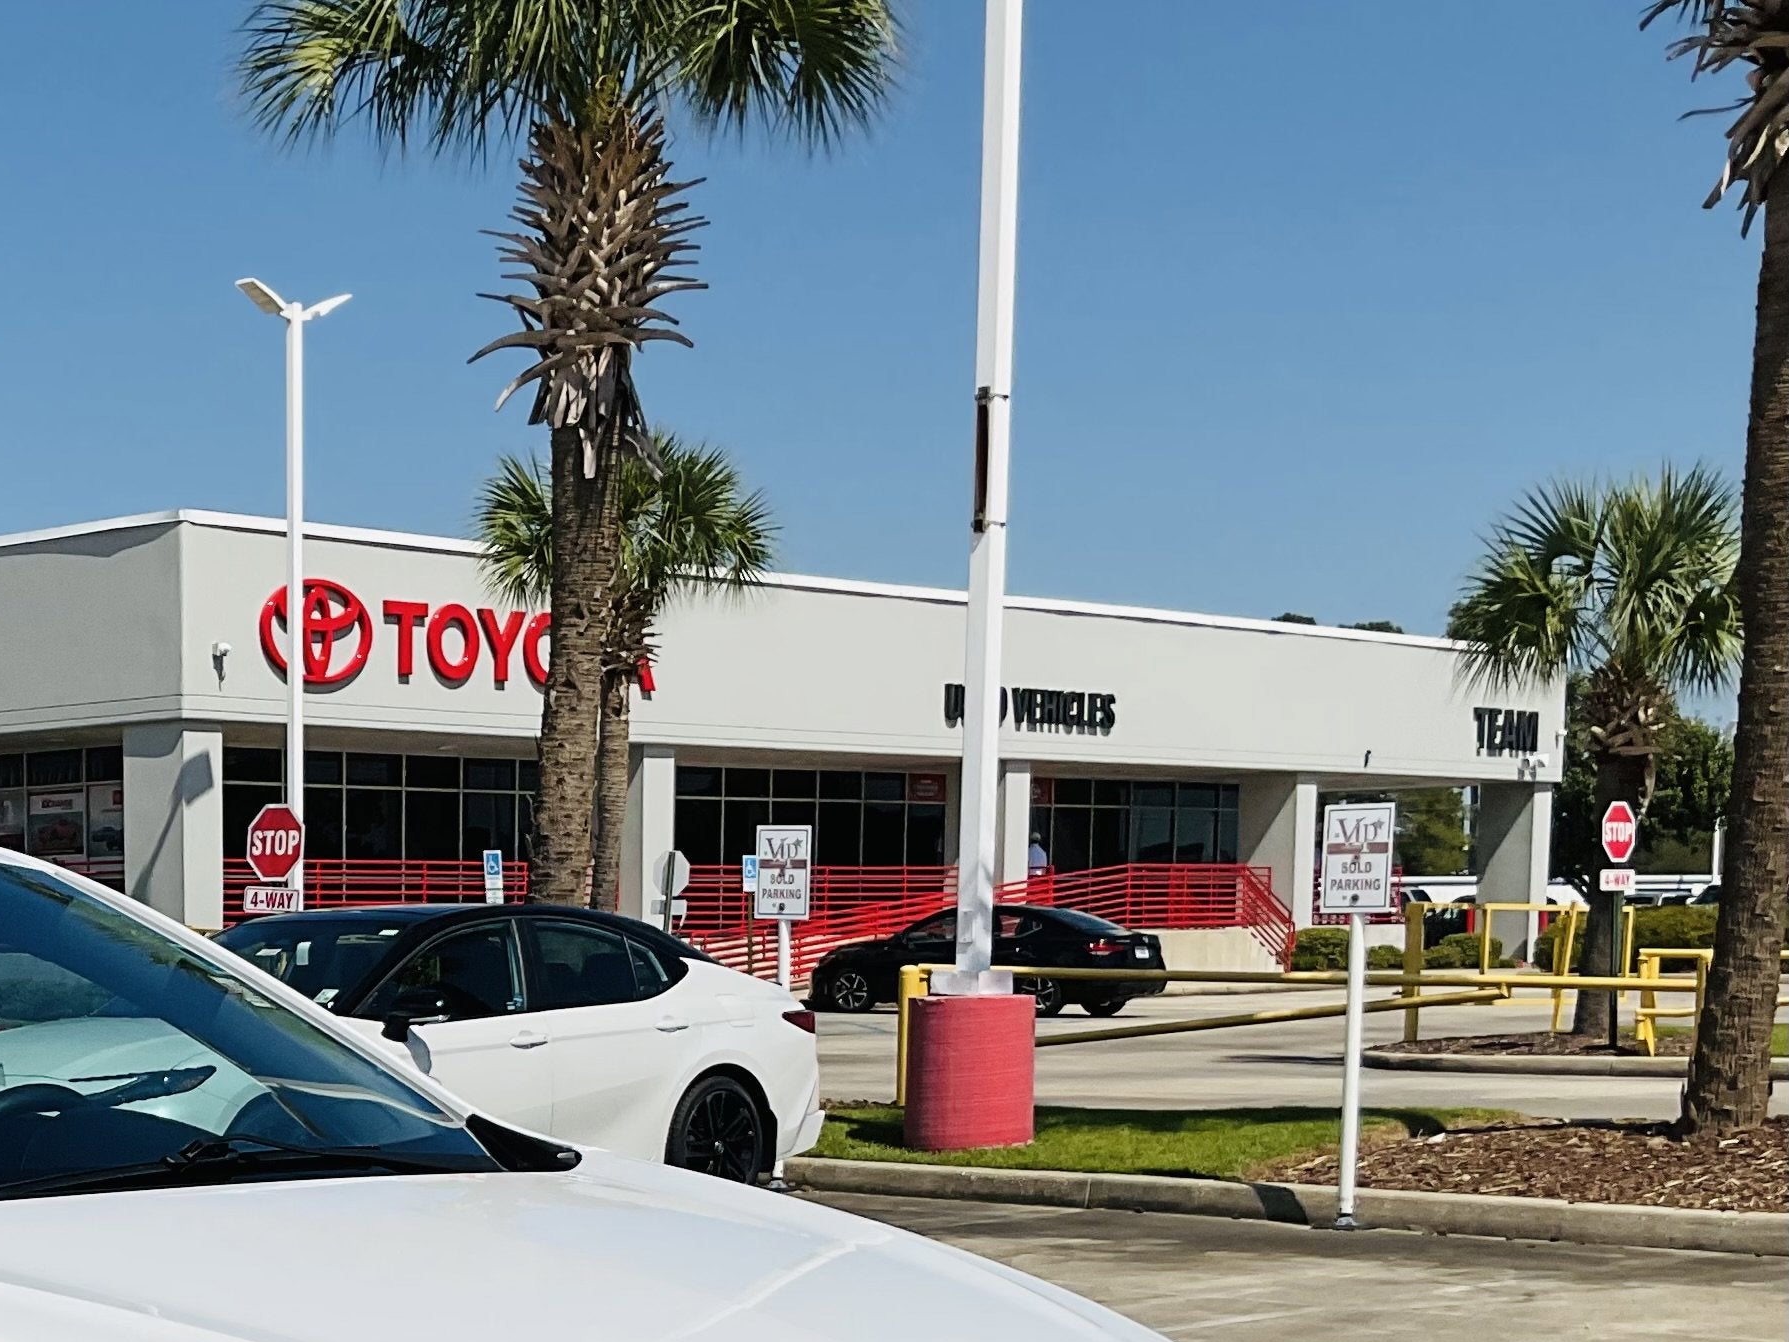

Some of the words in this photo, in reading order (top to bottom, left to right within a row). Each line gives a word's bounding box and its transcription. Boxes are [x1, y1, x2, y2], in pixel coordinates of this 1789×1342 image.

[383, 600, 655, 691] TOYO
[1011, 687, 1116, 729] VEHICLES
[1473, 707, 1539, 752] TEAM
[1605, 822, 1632, 842] STOP
[252, 830, 300, 856] STOP
[1341, 861, 1372, 874] SOLD
[770, 874, 795, 885] SOLD
[1330, 878, 1381, 891] PARKING
[250, 891, 294, 910] 4-WAY
[762, 888, 802, 900] PARKING
